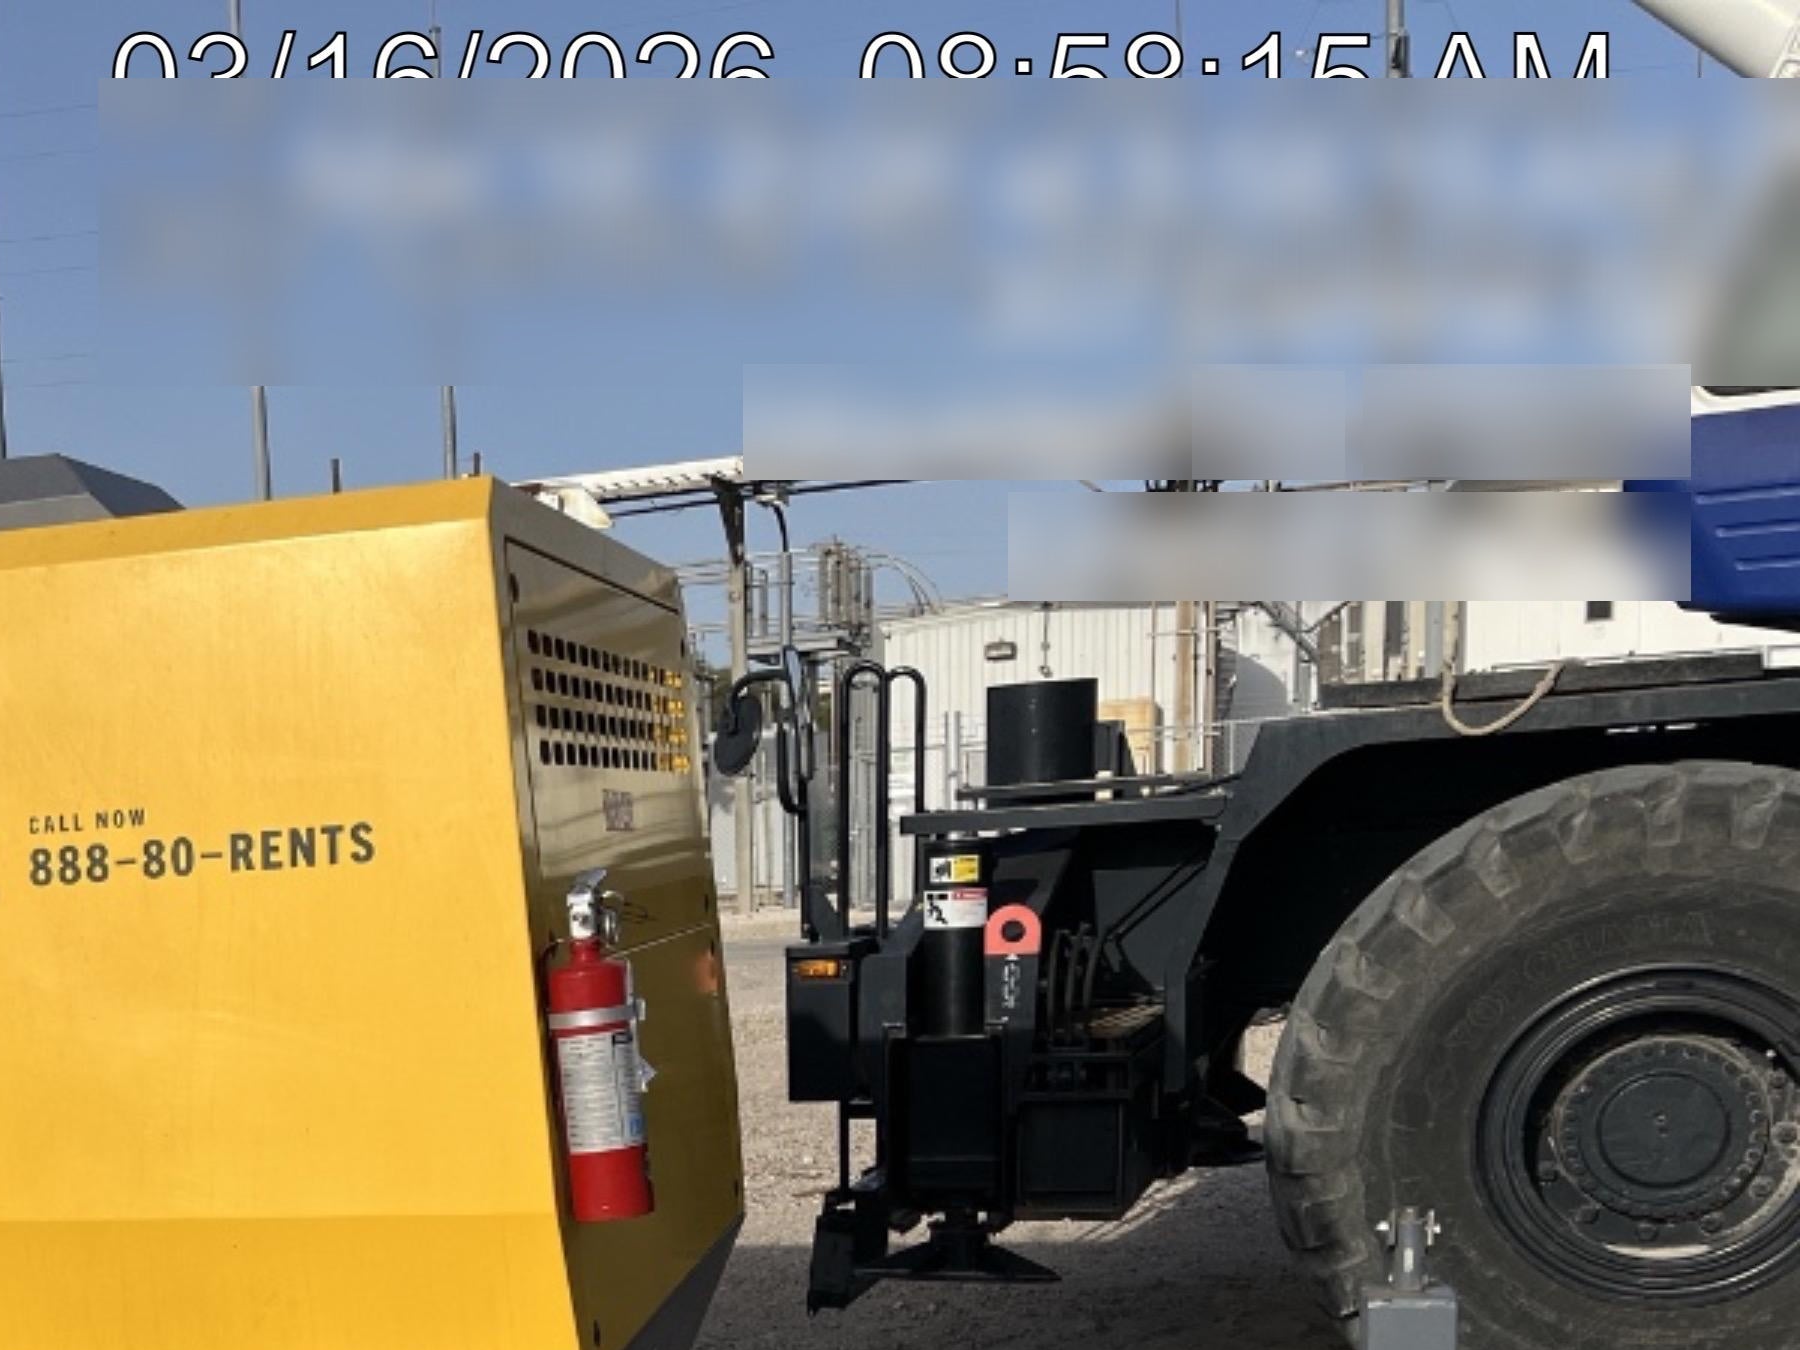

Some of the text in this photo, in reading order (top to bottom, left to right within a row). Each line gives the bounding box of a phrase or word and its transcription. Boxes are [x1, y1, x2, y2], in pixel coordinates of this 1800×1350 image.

[29, 807, 146, 834] CALL NOW
[29, 822, 375, 886] 888-80-RENTS
